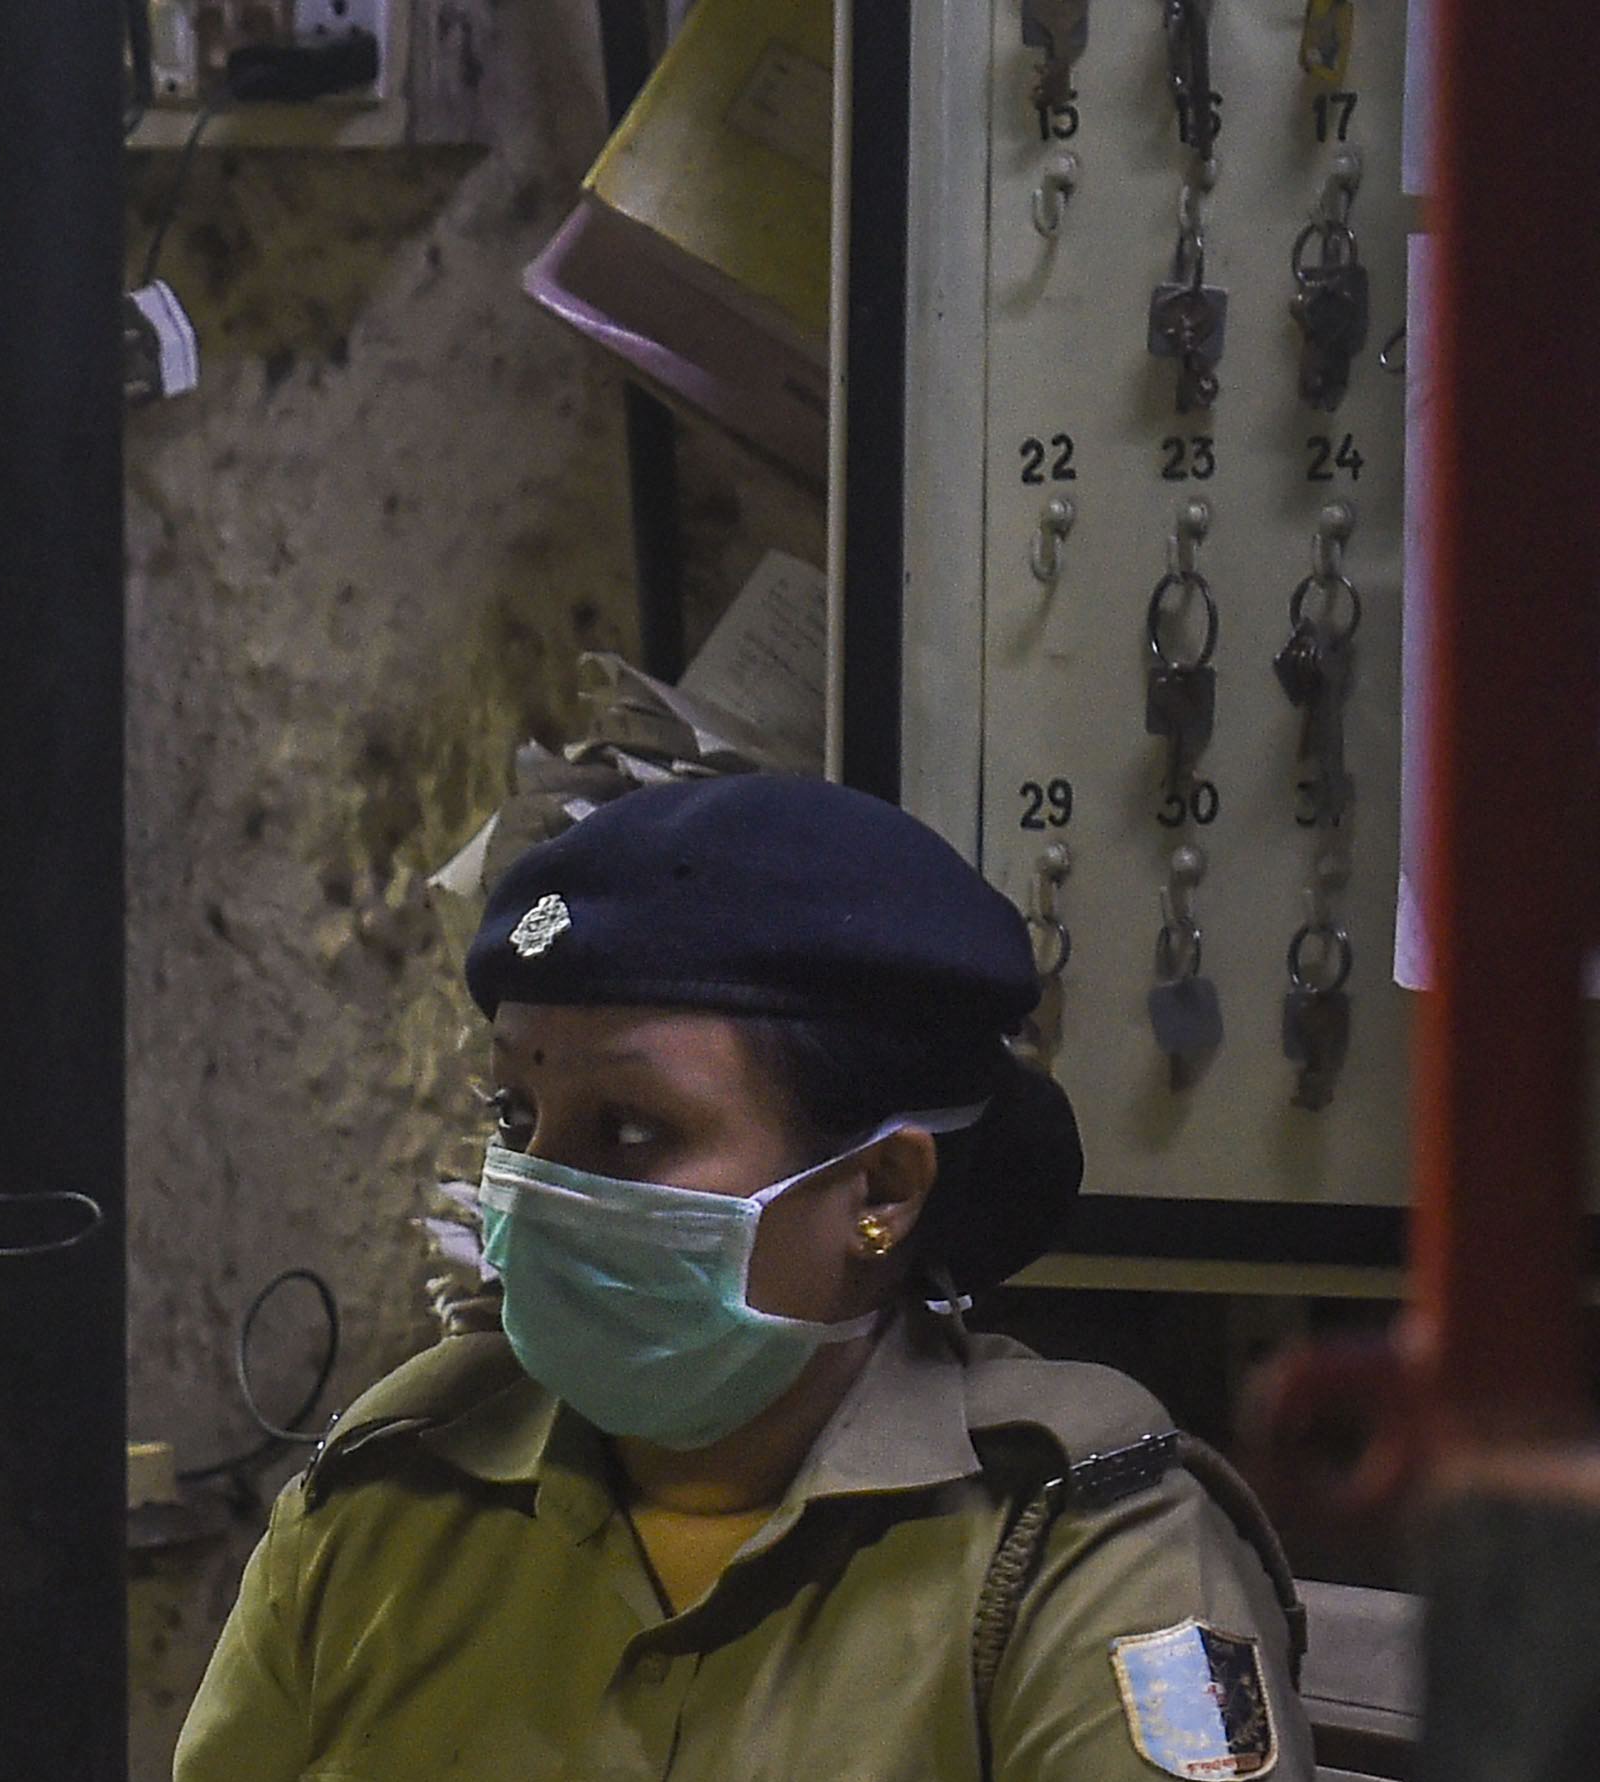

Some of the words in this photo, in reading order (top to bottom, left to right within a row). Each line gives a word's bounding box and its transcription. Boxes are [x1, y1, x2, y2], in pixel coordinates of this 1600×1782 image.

[1313, 92, 1357, 143] 17
[1019, 433, 1077, 484] 22
[1161, 436, 1215, 481] 23
[1305, 433, 1364, 481] 24
[1019, 779, 1072, 829] 29
